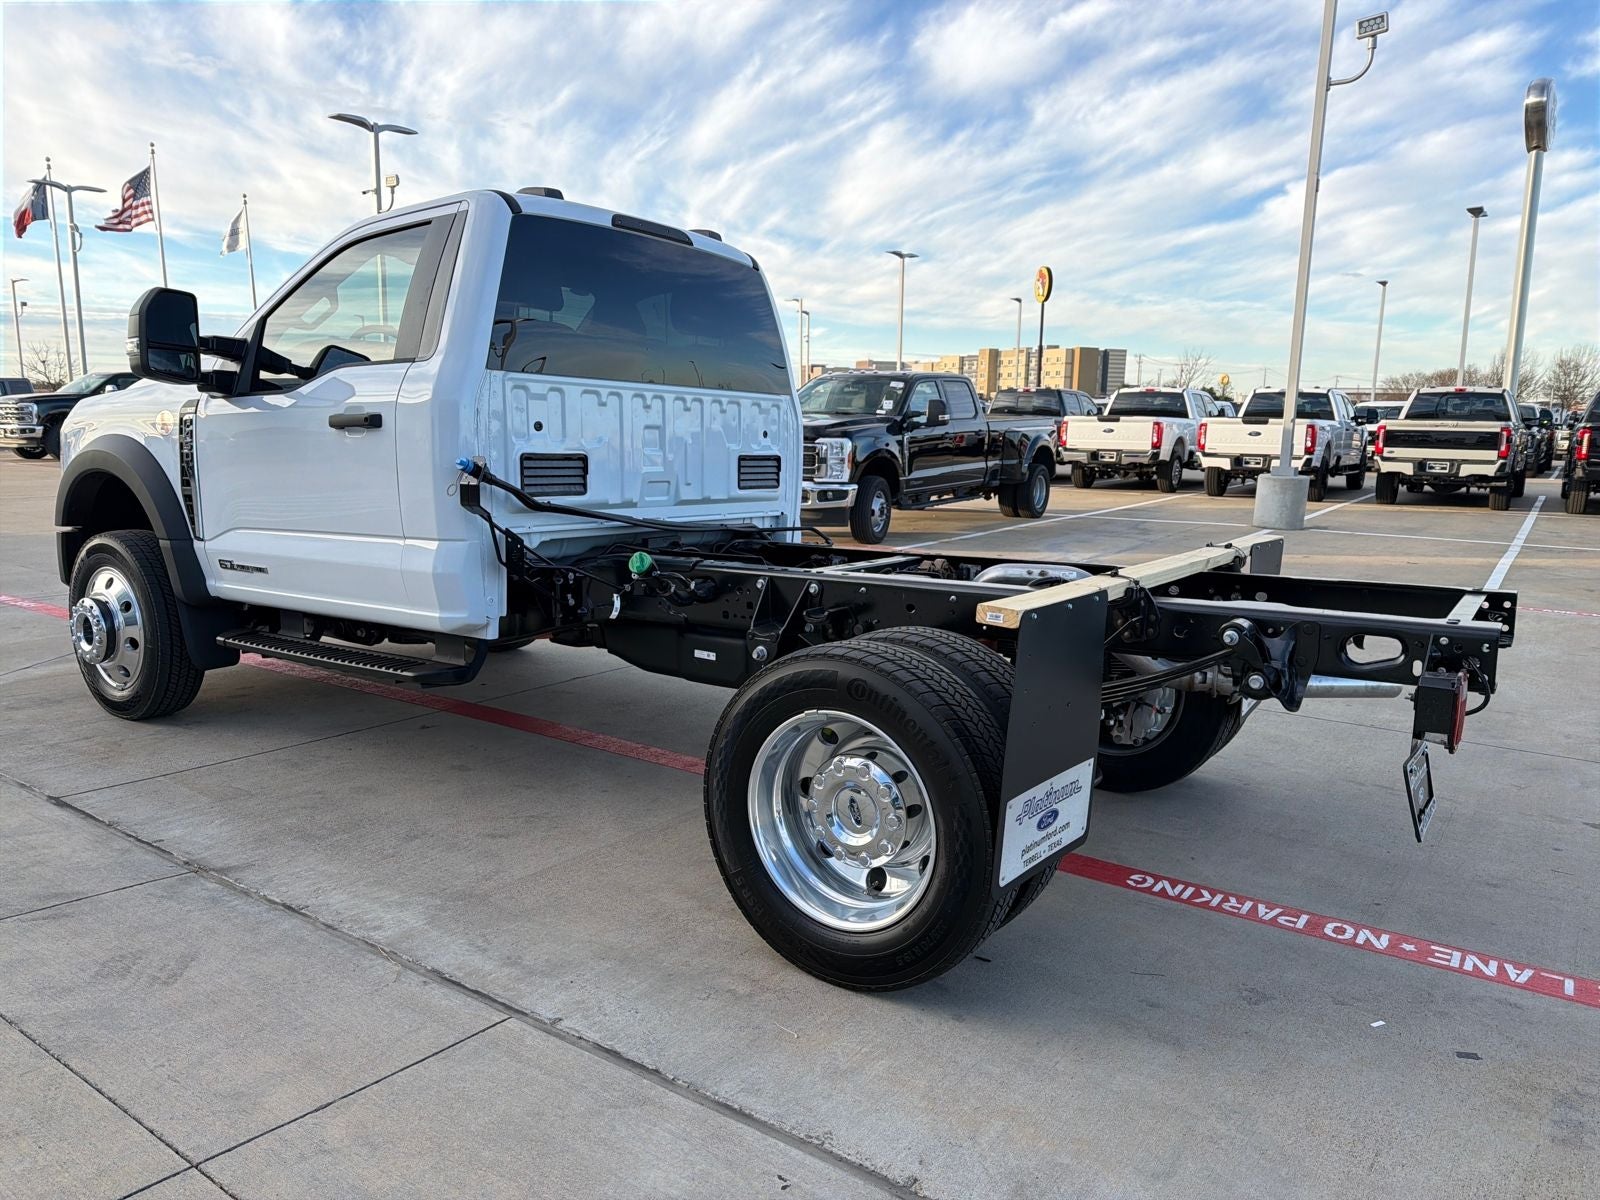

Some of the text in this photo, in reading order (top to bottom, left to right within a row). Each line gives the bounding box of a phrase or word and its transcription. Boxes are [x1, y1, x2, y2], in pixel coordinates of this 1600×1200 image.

[1015, 779, 1083, 826] Platinum
[1038, 810, 1058, 830] Ford
[1020, 821, 1071, 860] platinumford.com
[1022, 838, 1063, 869] TERRELL TEXAS
[1126, 874, 1575, 997] LANE NO PARKING
